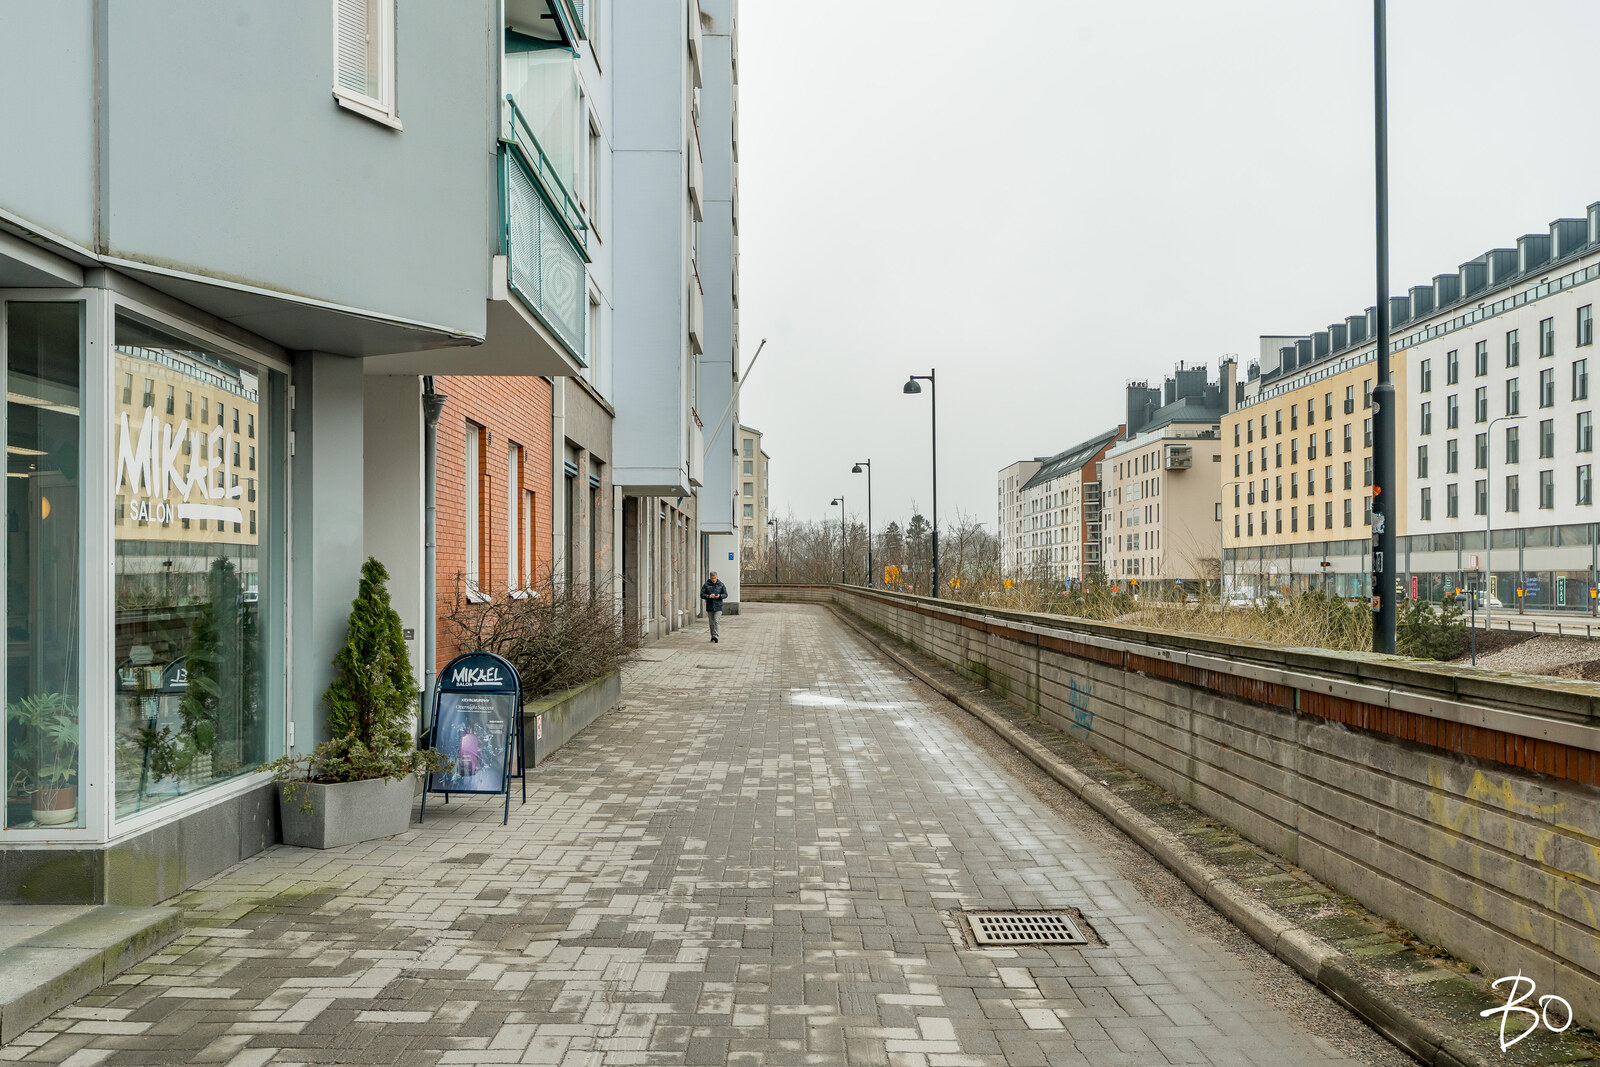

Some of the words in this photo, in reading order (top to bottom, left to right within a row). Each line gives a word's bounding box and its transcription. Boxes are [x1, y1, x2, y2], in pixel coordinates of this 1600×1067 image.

[116, 405, 243, 503] MIKAEL
[130, 499, 174, 524] SALON
[451, 667, 503, 683] MIKAEL
